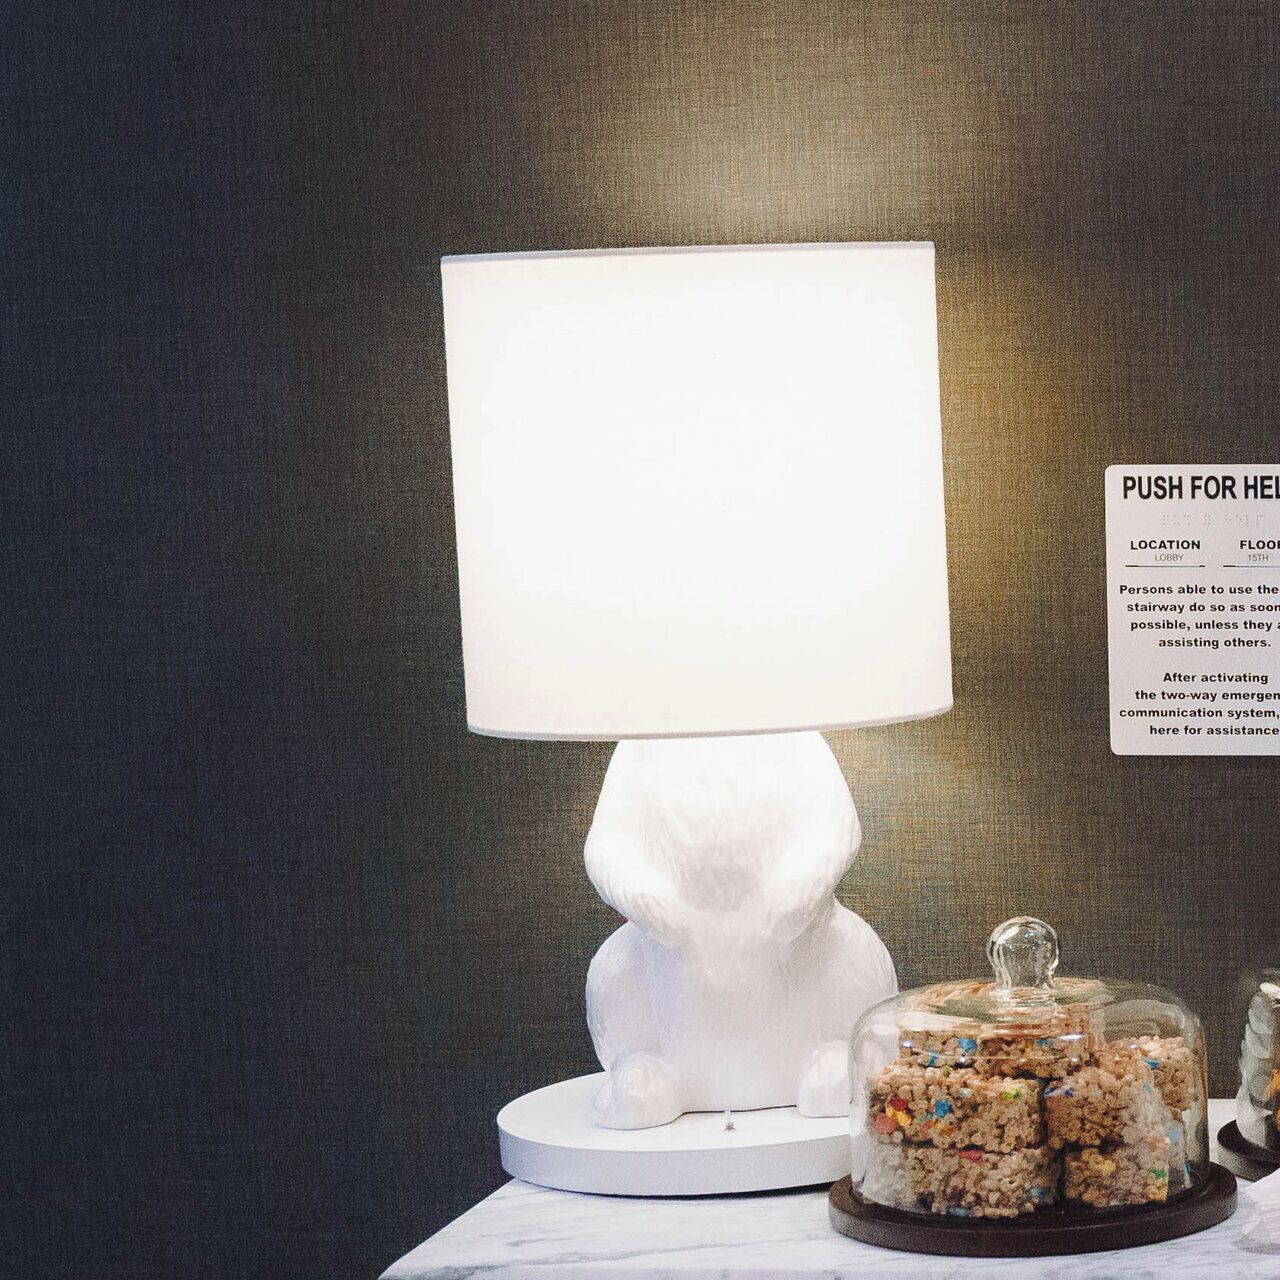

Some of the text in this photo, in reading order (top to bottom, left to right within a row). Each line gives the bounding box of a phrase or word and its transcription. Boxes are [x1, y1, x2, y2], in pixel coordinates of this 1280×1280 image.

[1123, 475, 1183, 500] PUSH
[1191, 475, 1237, 500] FOR
[1130, 539, 1201, 550] LOCATION
[1154, 553, 1184, 562] LOBBY
[1248, 553, 1269, 562] 15TH
[1119, 585, 1173, 595] Persons
[1178, 585, 1206, 595] able
[1211, 586, 1224, 595] to
[1229, 586, 1253, 595] use
[1257, 585, 1279, 595] the
[1127, 603, 1184, 614] stairway
[1189, 603, 1205, 612] do
[1210, 604, 1225, 612] so
[1230, 604, 1245, 612] as
[1130, 620, 1190, 631] possible,
[1195, 620, 1238, 630] unless
[1243, 620, 1272, 631] they
[1158, 637, 1271, 649] assisting others.
[1163, 672, 1269, 684] After activating
[1135, 690, 1156, 700] the
[1161, 690, 1217, 702] two-way
[1119, 707, 1223, 718] communication
[1227, 708, 1280, 720] system,
[1149, 725, 1180, 735] here
[1184, 725, 1202, 735] for
